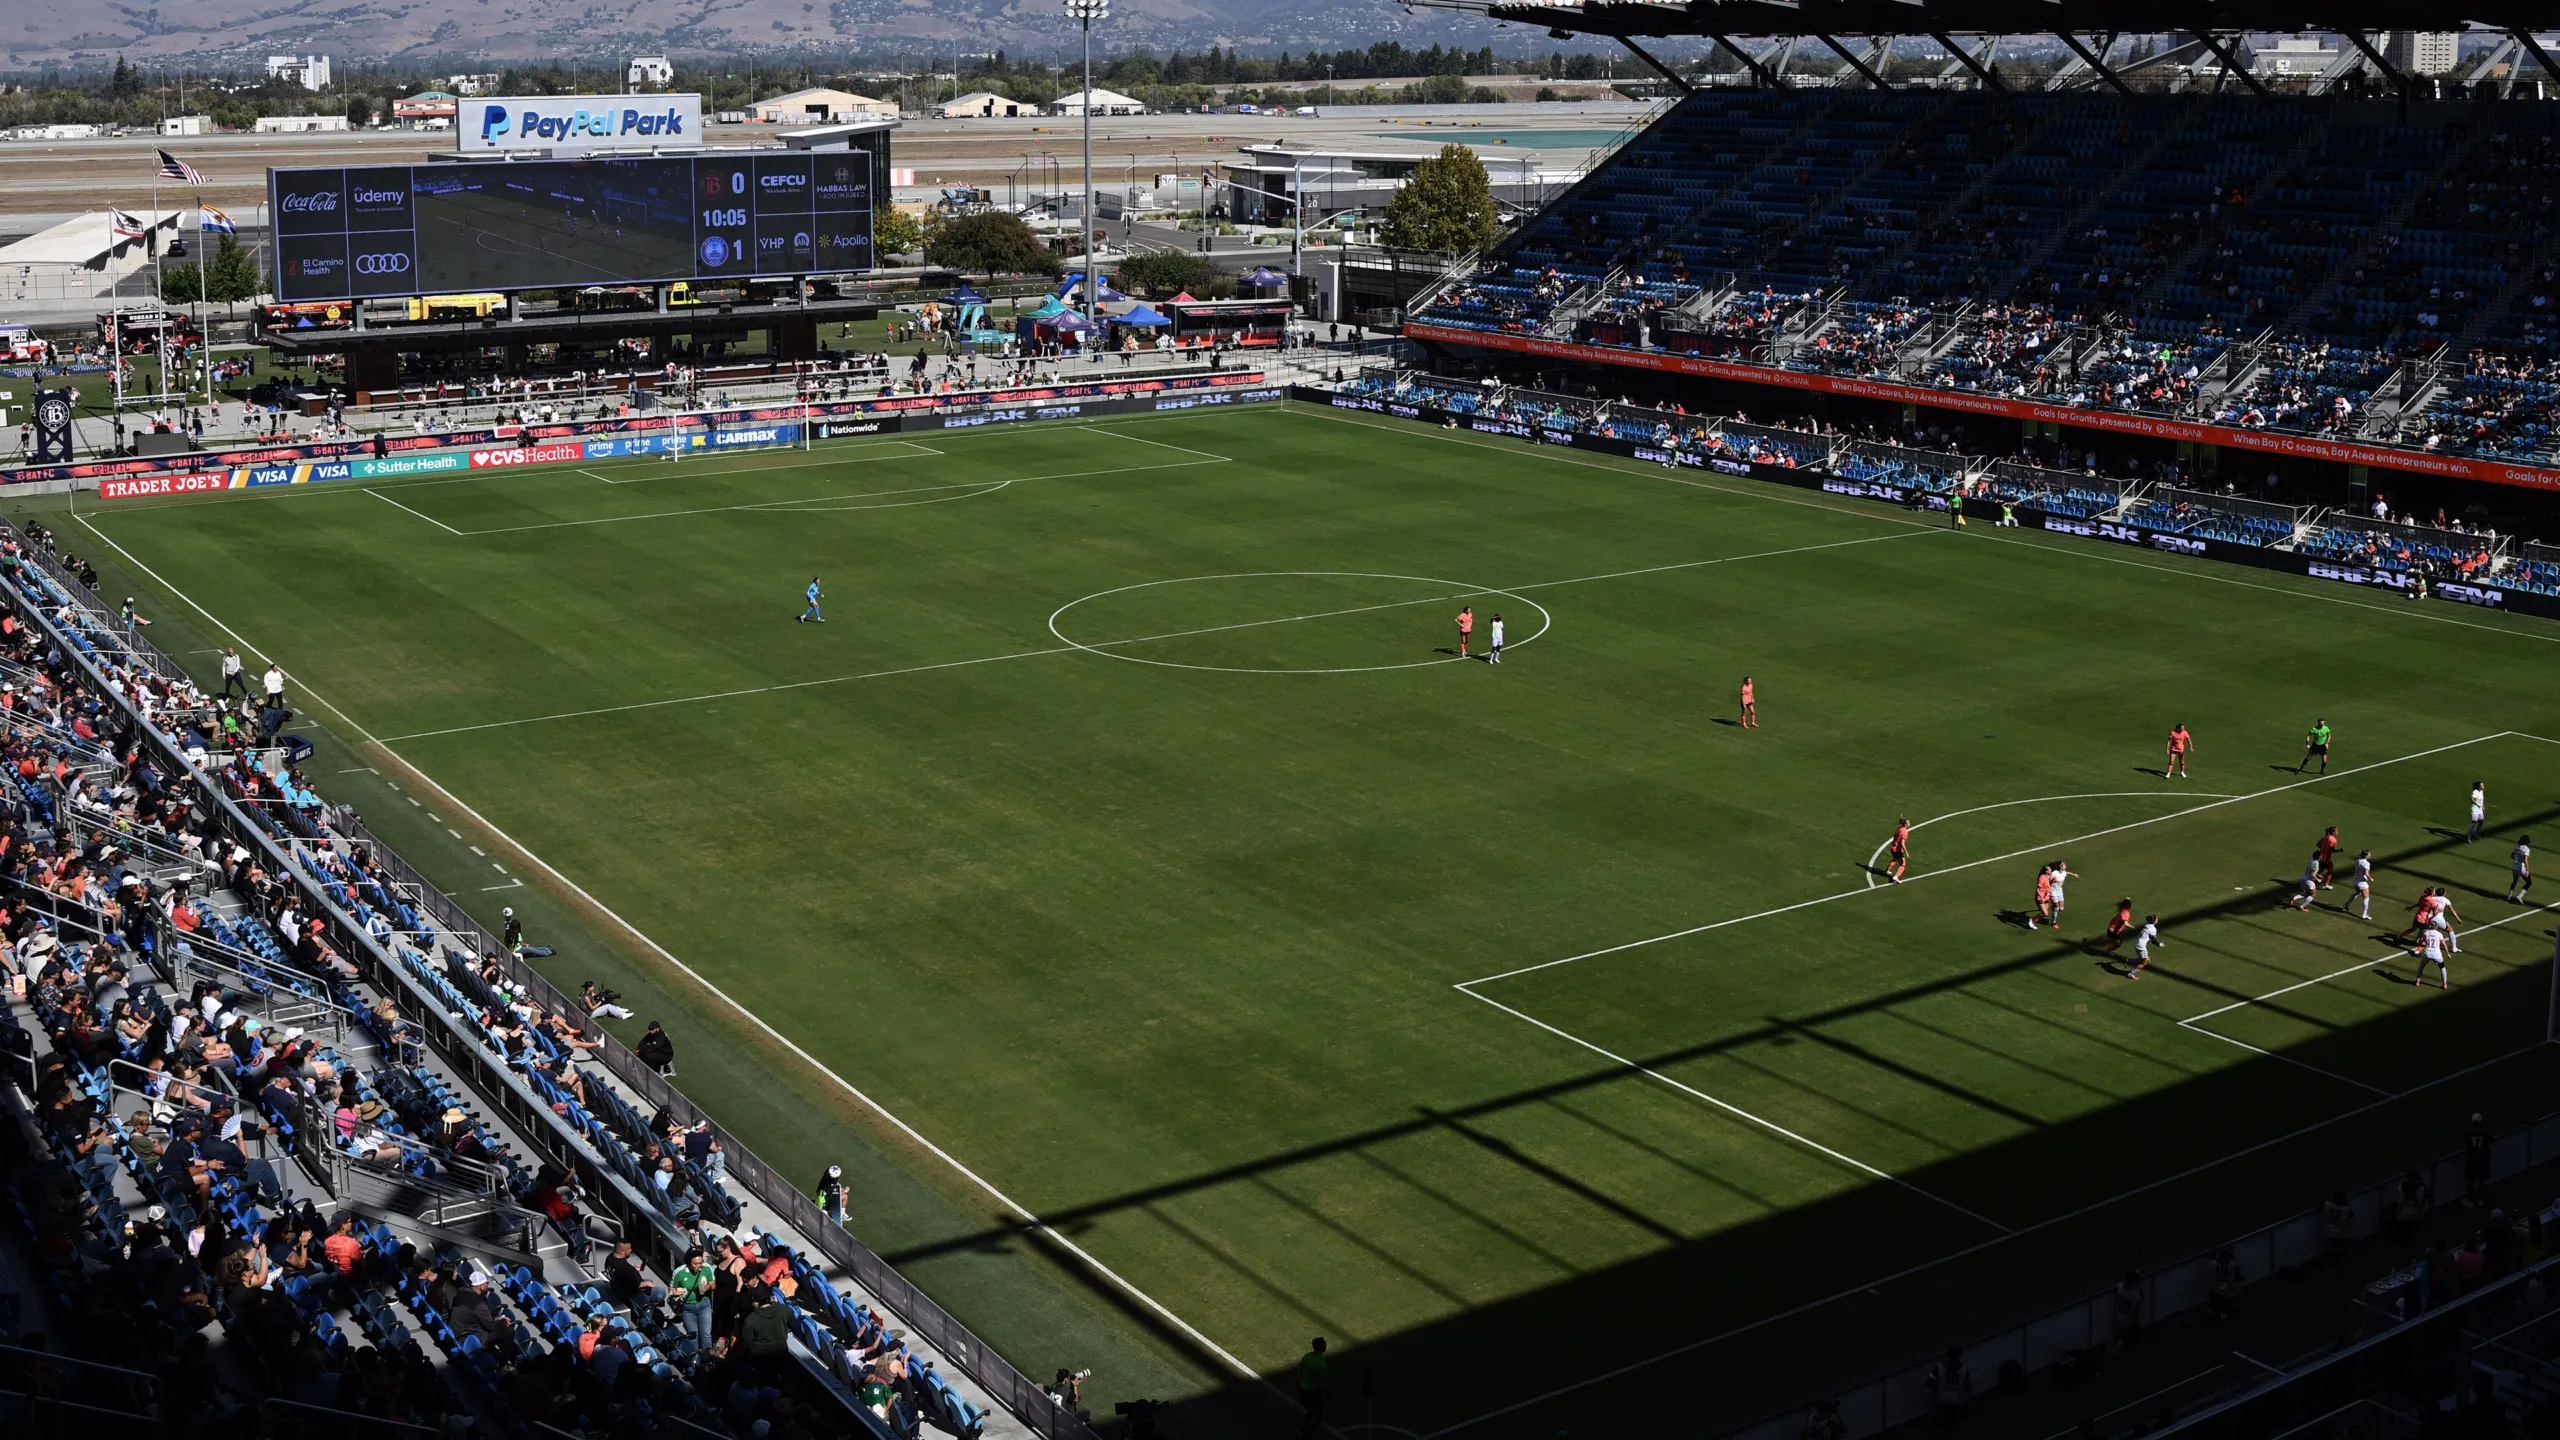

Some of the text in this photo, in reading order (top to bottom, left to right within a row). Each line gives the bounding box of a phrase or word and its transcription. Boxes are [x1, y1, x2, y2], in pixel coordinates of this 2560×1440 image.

[521, 108, 682, 141] PayPal Park
[732, 172, 744, 194] 0
[760, 175, 806, 187] CEFCU
[354, 187, 404, 205] udemy
[1307, 200, 1318, 208] 20
[703, 209, 746, 227] 10:05
[734, 239, 742, 260] 1
[760, 237, 784, 249] VHP
[833, 234, 868, 248] Apollo
[303, 267, 330, 275] Health
[1410, 327, 1424, 336] Goals
[1449, 332, 1474, 342] presented
[1474, 335, 1480, 344] by
[1527, 342, 1542, 351] When
[1543, 344, 1553, 353] Bay
[1583, 349, 1593, 359] Bay
[1594, 351, 1607, 359] Area
[1609, 353, 1648, 365] entrepreneurs
[1681, 361, 1698, 371] Goals
[1708, 365, 1730, 376] Grants,
[1731, 368, 1761, 380] presented
[1762, 371, 1771, 381] by
[1430, 381, 1462, 391] COMMUNITY
[1155, 394, 1232, 410] BREAK
[1331, 394, 1384, 412] BREAK
[1831, 381, 1852, 390] When
[1853, 383, 1866, 394] Bay
[1867, 386, 1877, 394] FC
[1905, 390, 1918, 401] Bay
[1919, 393, 1937, 402] Area
[1939, 396, 1991, 412] entrepreneurs
[944, 408, 1027, 428] BREAK
[2034, 407, 2056, 419] Goals
[2057, 410, 2068, 419] for
[2070, 412, 2098, 424] Grants,
[2100, 416, 2140, 429] presented
[2142, 421, 2152, 433] by
[830, 423, 880, 435] Nationwide
[1472, 418, 1533, 437] BREAK
[461, 432, 484, 442] BAY FC
[625, 438, 650, 450] prime
[588, 442, 613, 453] prime
[2233, 434, 2260, 445] When
[2262, 438, 2279, 449] Bay
[2282, 440, 2294, 450] FC
[2331, 447, 2350, 459] Bay
[2351, 450, 2375, 462] Area
[2377, 454, 2448, 471] entrepreneurs
[315, 465, 349, 478] VISA
[378, 456, 456, 473] Sutter Health
[254, 469, 288, 483] VISA
[2506, 469, 2536, 482] Goals
[2538, 473, 2553, 483] for
[106, 475, 222, 497] TRADER JOE'S
[1822, 478, 1905, 502] BREAK
[2044, 516, 2142, 543] BREAK
[2427, 938, 2435, 948] 12
[2471, 1136, 2484, 1148] 17
[2331, 1210, 2341, 1220] 17
